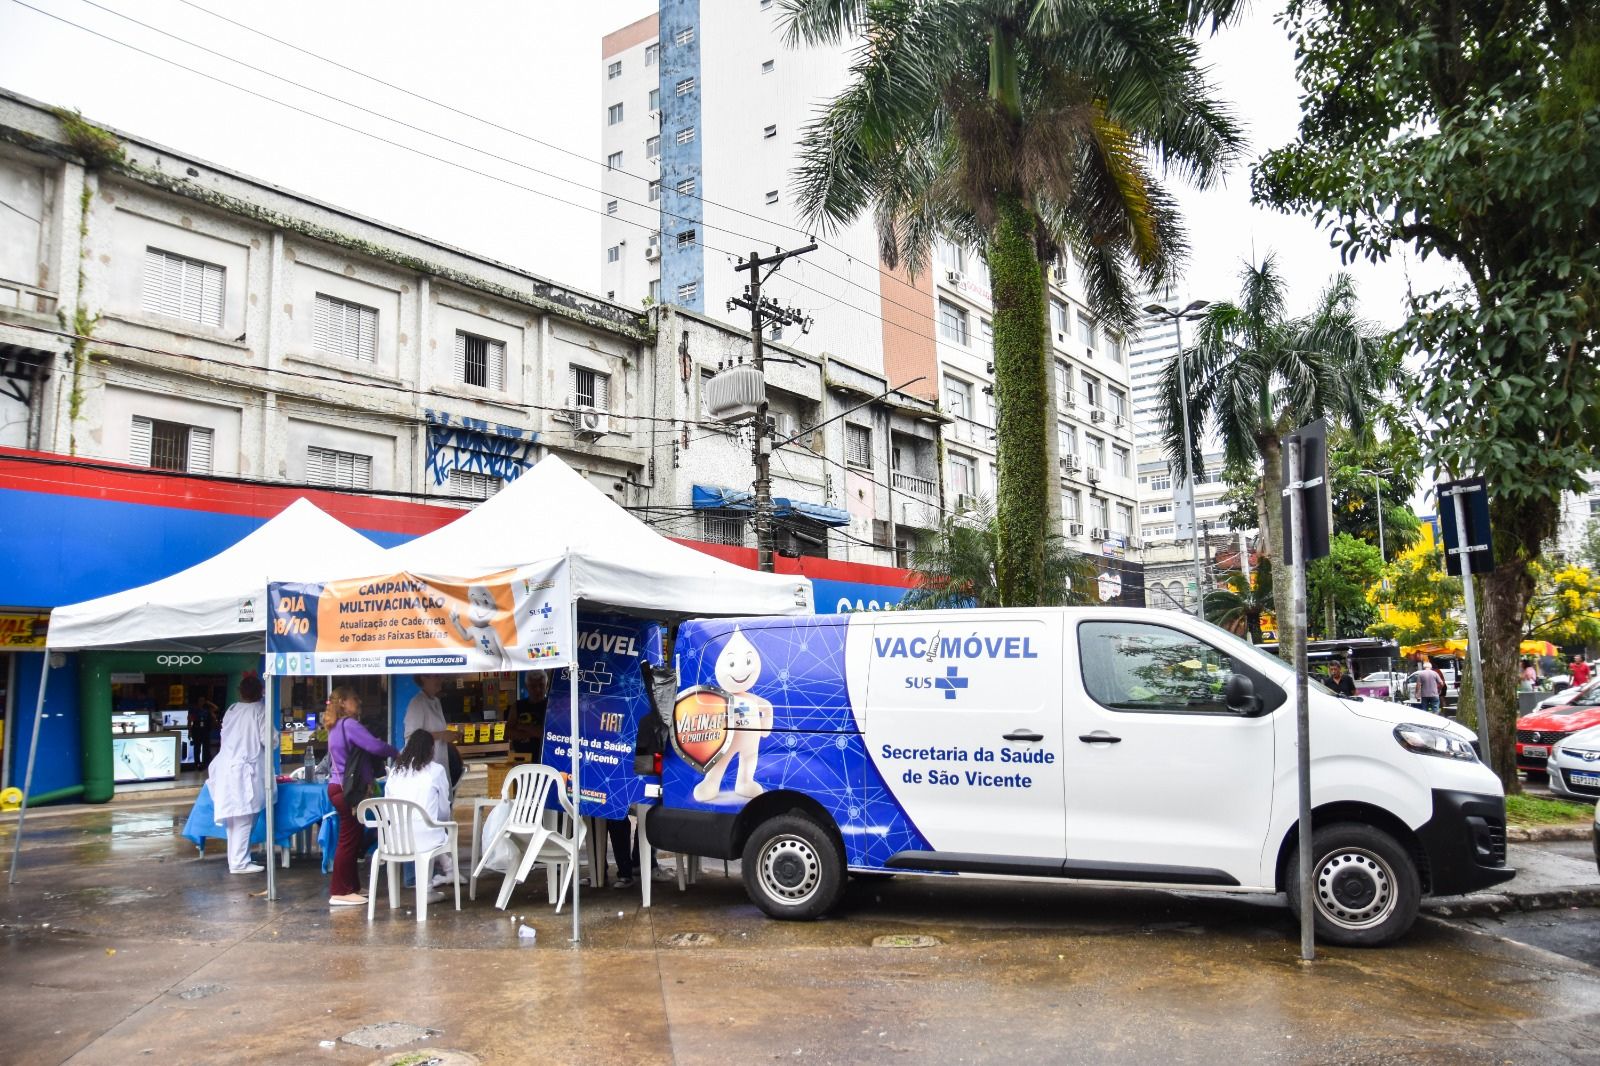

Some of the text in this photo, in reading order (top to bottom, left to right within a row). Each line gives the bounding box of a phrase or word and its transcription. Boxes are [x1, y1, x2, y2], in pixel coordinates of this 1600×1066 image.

[278, 596, 305, 613] DIA
[340, 594, 446, 613] MULTIVACINAÇÃO
[273, 616, 310, 636] 18/10
[340, 618, 387, 630] Atualização
[389, 617, 399, 627] de
[340, 628, 448, 643] de Todas as Faixas Etárias
[156, 655, 203, 667] oppo
[905, 676, 932, 689] SUS
[599, 711, 625, 734] FIAT
[590, 739, 602, 749] da
[603, 740, 632, 753] Saúde
[881, 744, 1055, 764] Secretaria da Saúde
[555, 746, 566, 756] de
[585, 751, 618, 765] Vicente
[902, 769, 1032, 788] de São Vicente
